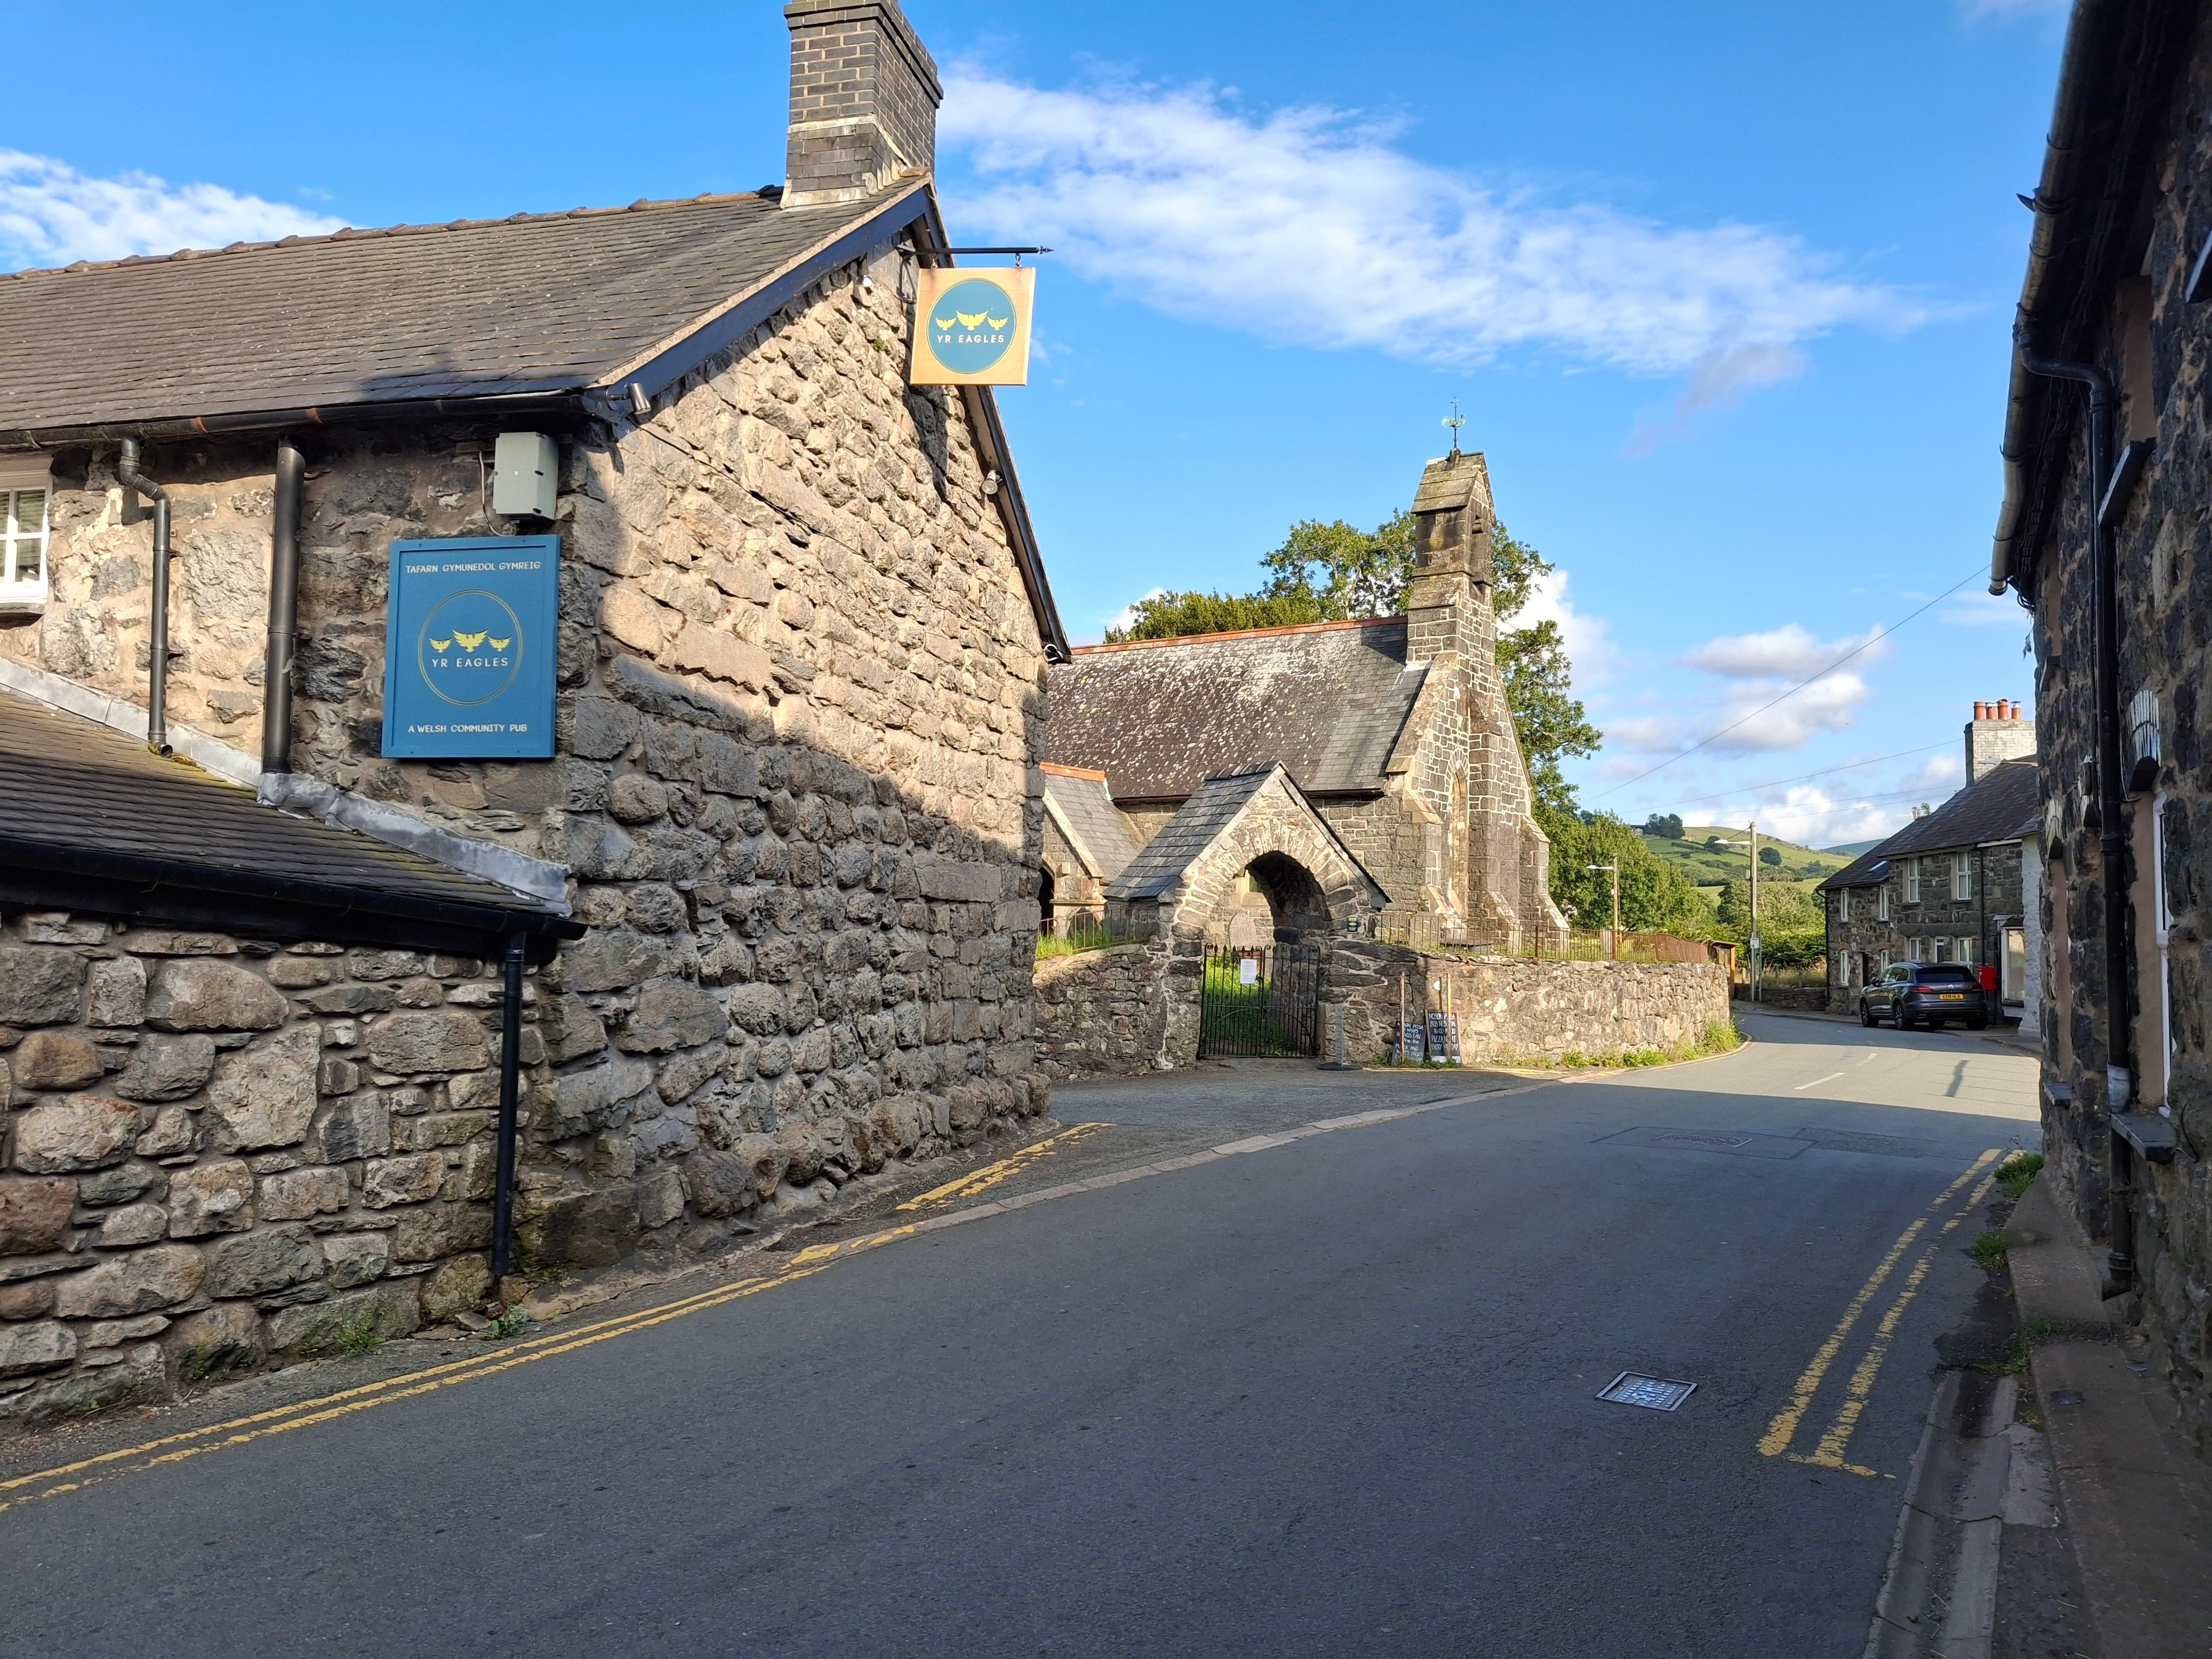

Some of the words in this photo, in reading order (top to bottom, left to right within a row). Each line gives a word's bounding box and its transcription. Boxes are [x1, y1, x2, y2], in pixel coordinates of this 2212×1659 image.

[937, 335, 951, 343] YR
[959, 335, 1004, 343] EAGLES
[406, 564, 438, 574] TAFARN
[442, 563, 496, 572] GYMUNEDOL
[499, 561, 541, 570] GYMREIG
[432, 658, 448, 668] YR
[456, 657, 509, 667] EAGLES
[408, 725, 414, 733] A
[417, 724, 447, 733] WELSH
[451, 724, 505, 732] COMMUNITY
[510, 724, 527, 732] PUB
[1431, 1035, 1443, 1043] PIZZA
